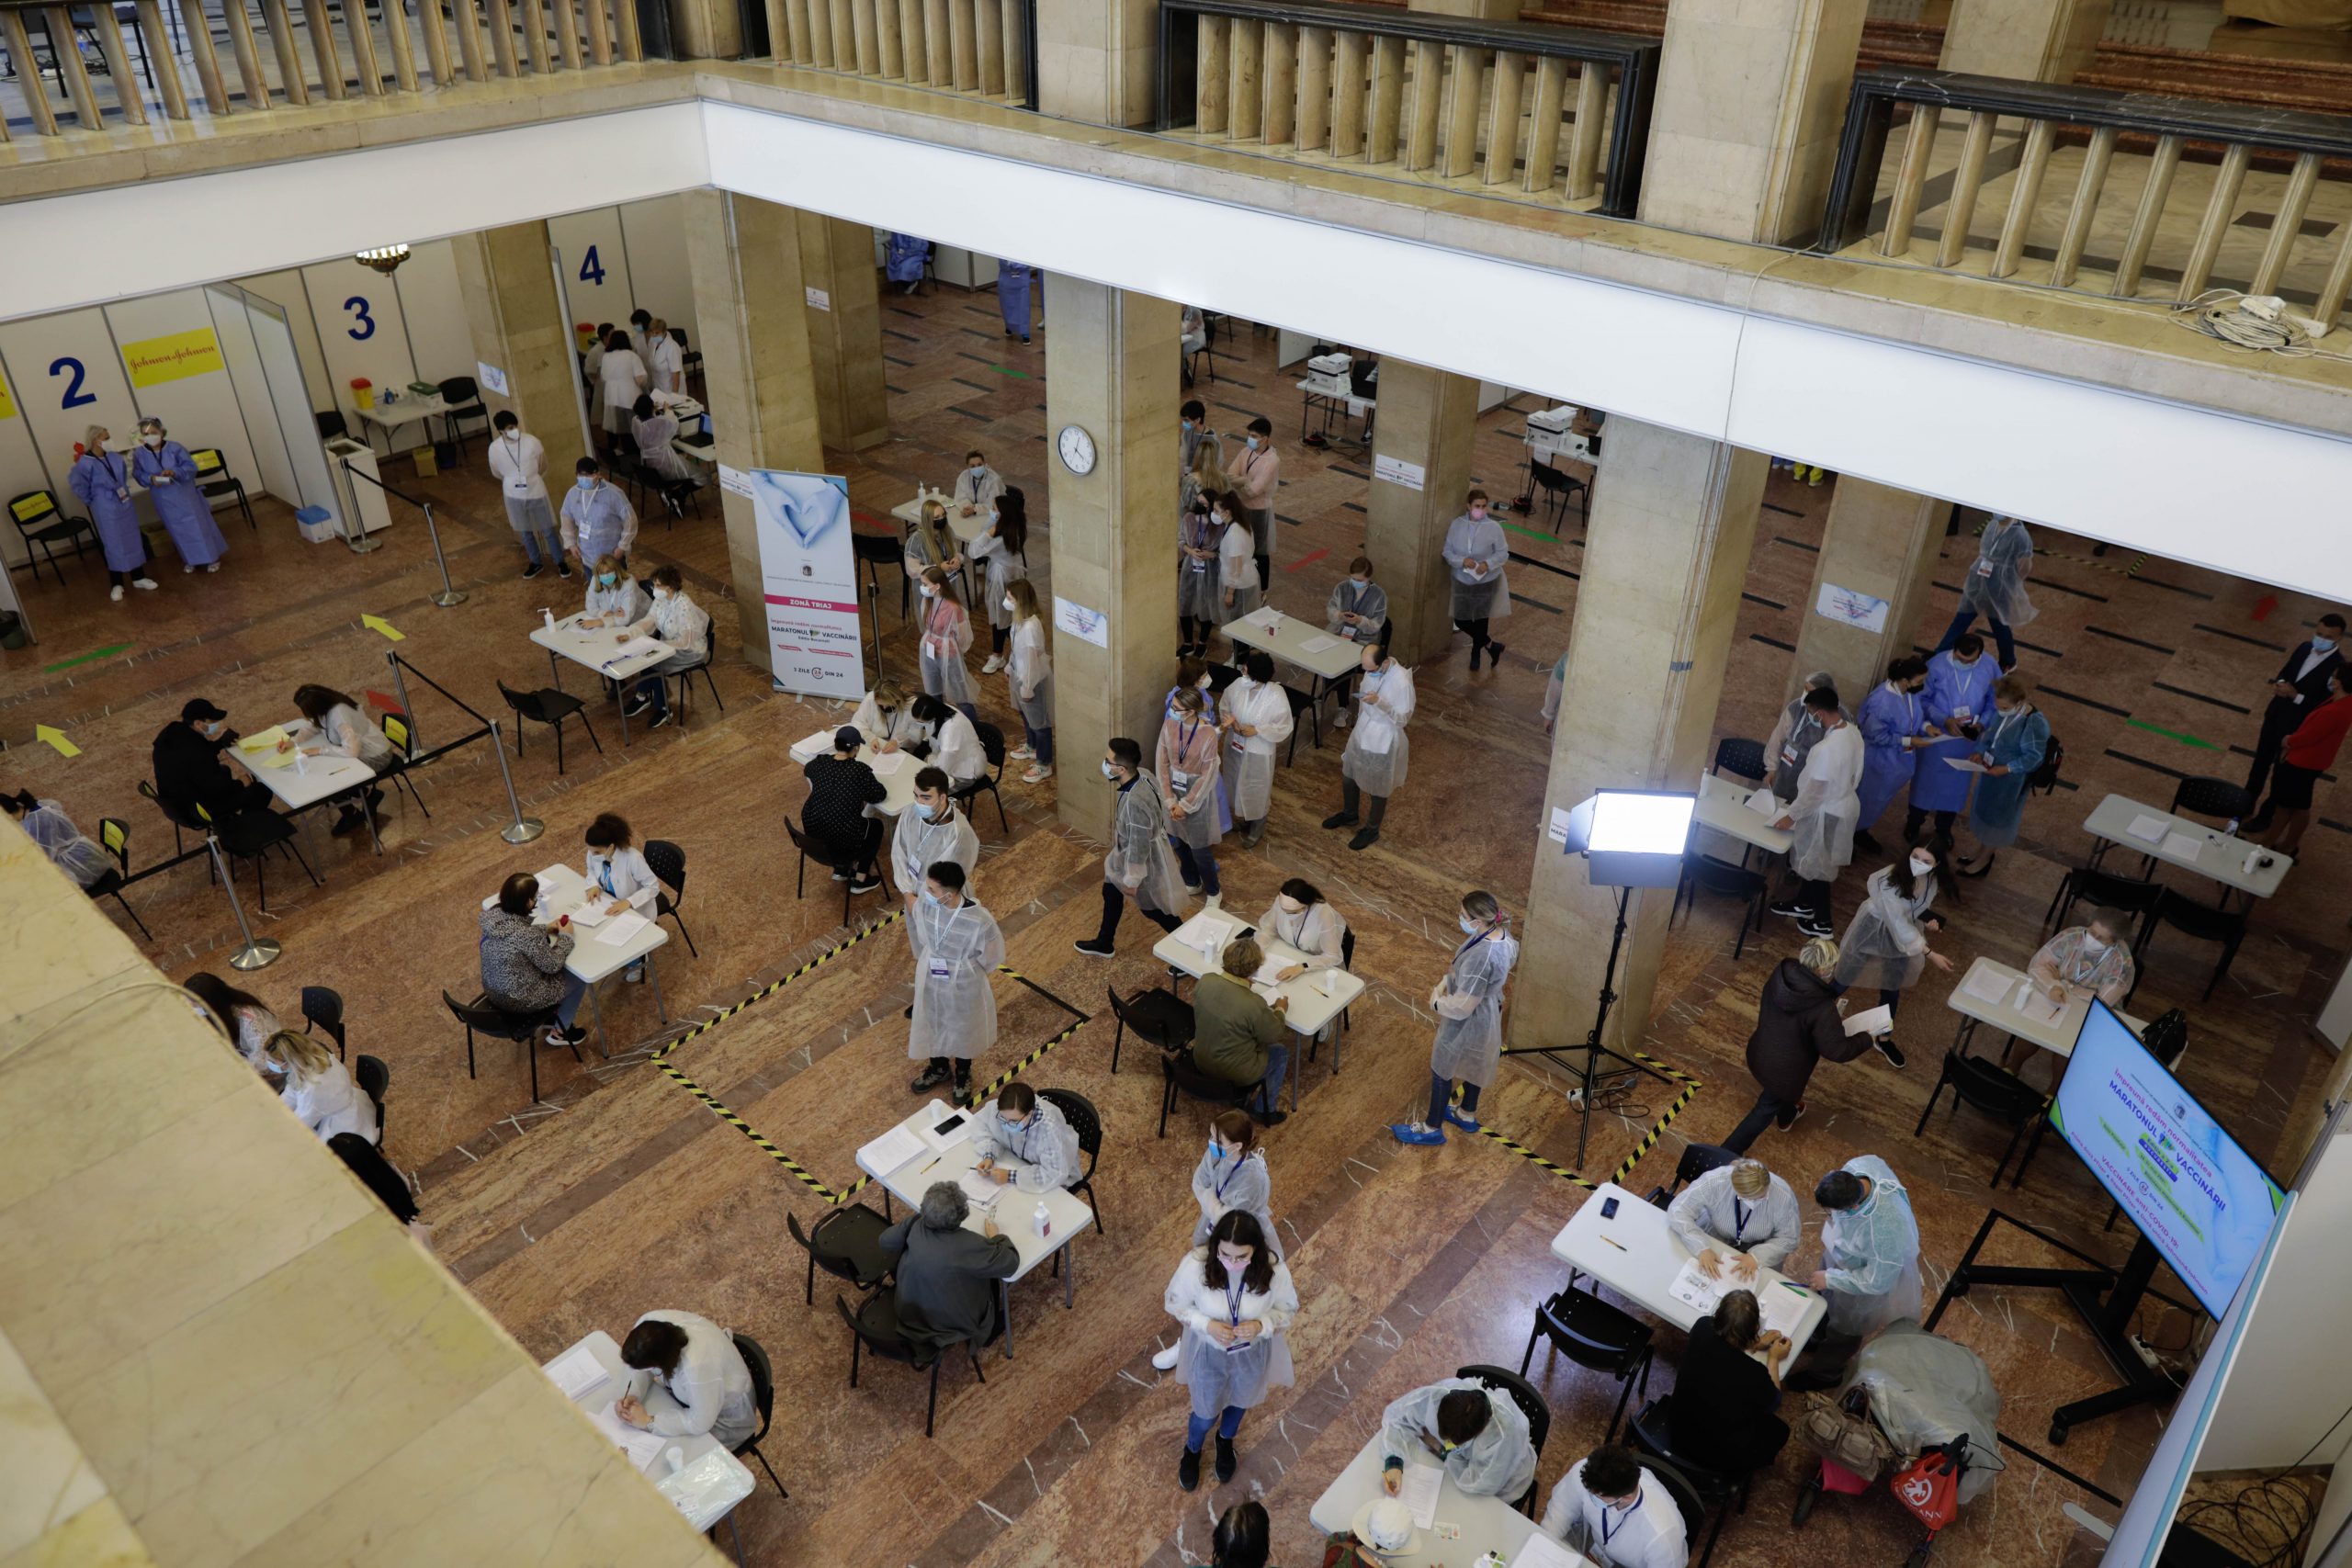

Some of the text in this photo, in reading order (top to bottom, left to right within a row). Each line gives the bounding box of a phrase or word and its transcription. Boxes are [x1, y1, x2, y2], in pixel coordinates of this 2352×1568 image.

[580, 244, 605, 286] 4
[344, 296, 375, 341] 3
[50, 356, 96, 410] 2
[789, 599, 809, 607] ZONĂ
[772, 626, 808, 635] MARATONUL
[2109, 1078, 2159, 1138] MARATONUL
[2174, 1149, 2227, 1213] VACCINĂRII
[2167, 1125, 2212, 1179] normalitatea
[2101, 1154, 2135, 1197] VACCINARE
